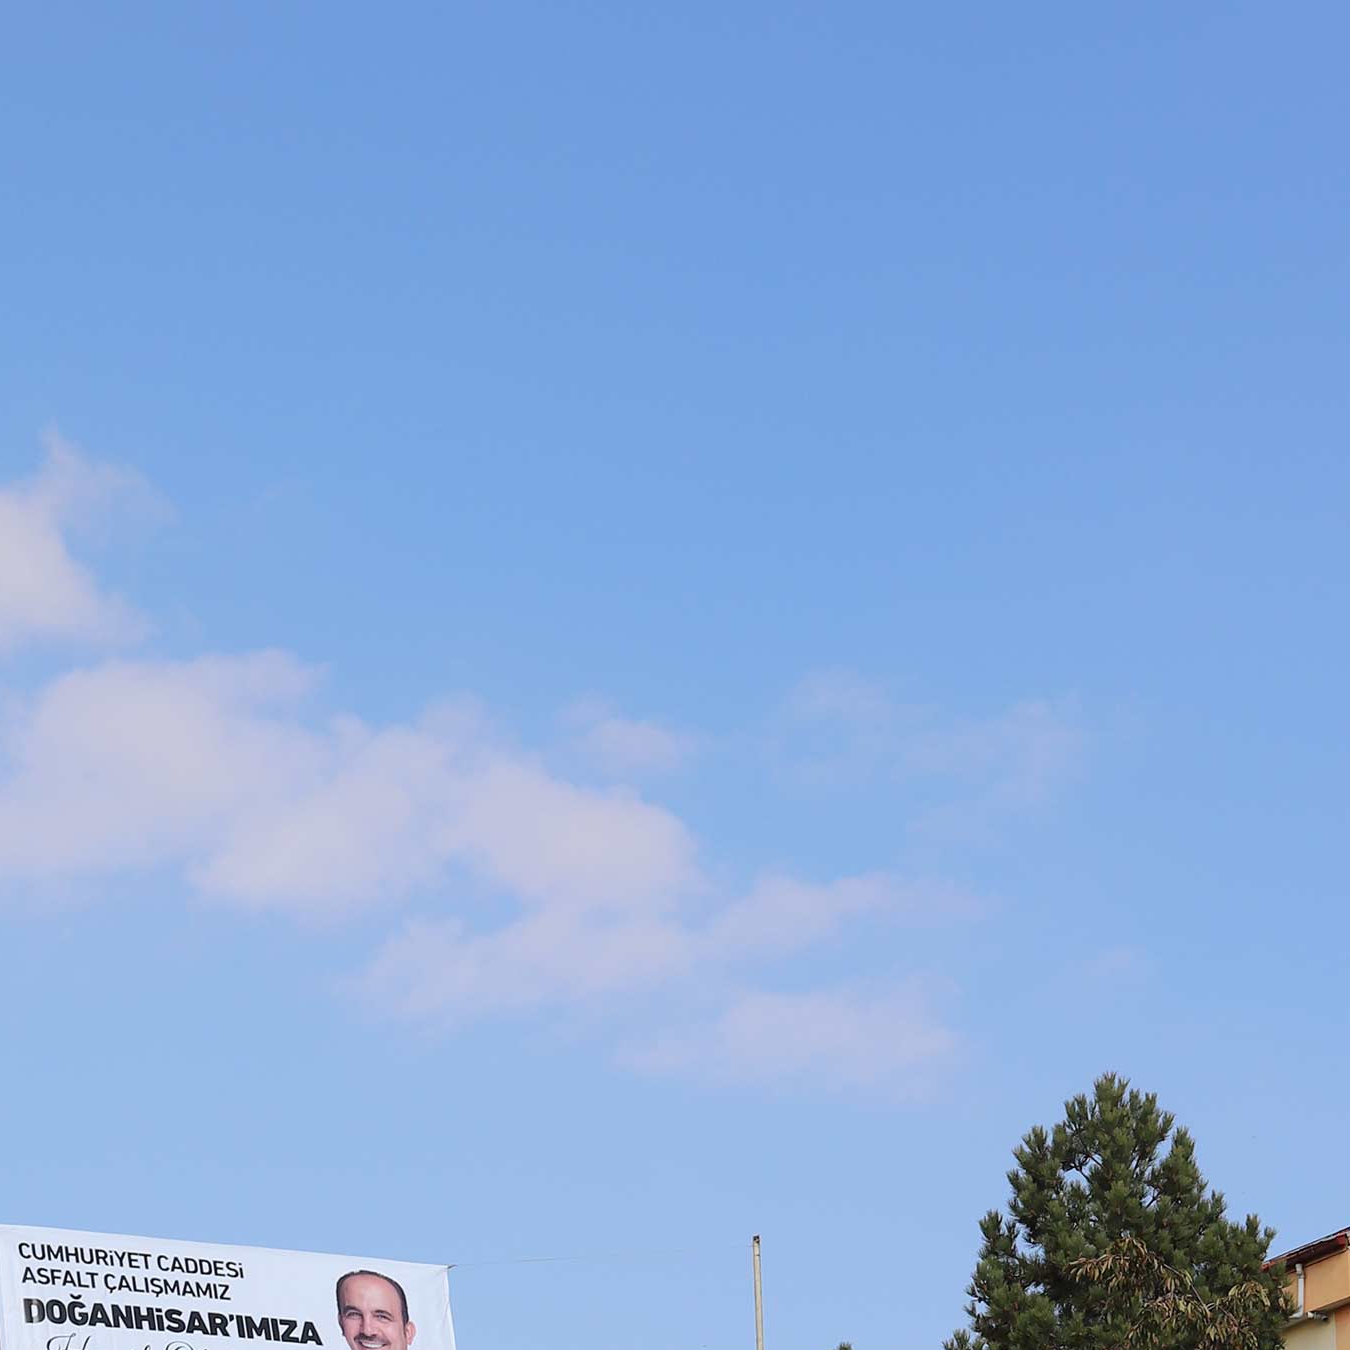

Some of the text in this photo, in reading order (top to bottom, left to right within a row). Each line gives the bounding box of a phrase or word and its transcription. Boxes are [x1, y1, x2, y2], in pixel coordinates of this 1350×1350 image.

[18, 1242, 244, 1279] CUMHURİYET CADDESİ
[22, 1267, 232, 1301] ASFALT ÇALIŞMAMIZ
